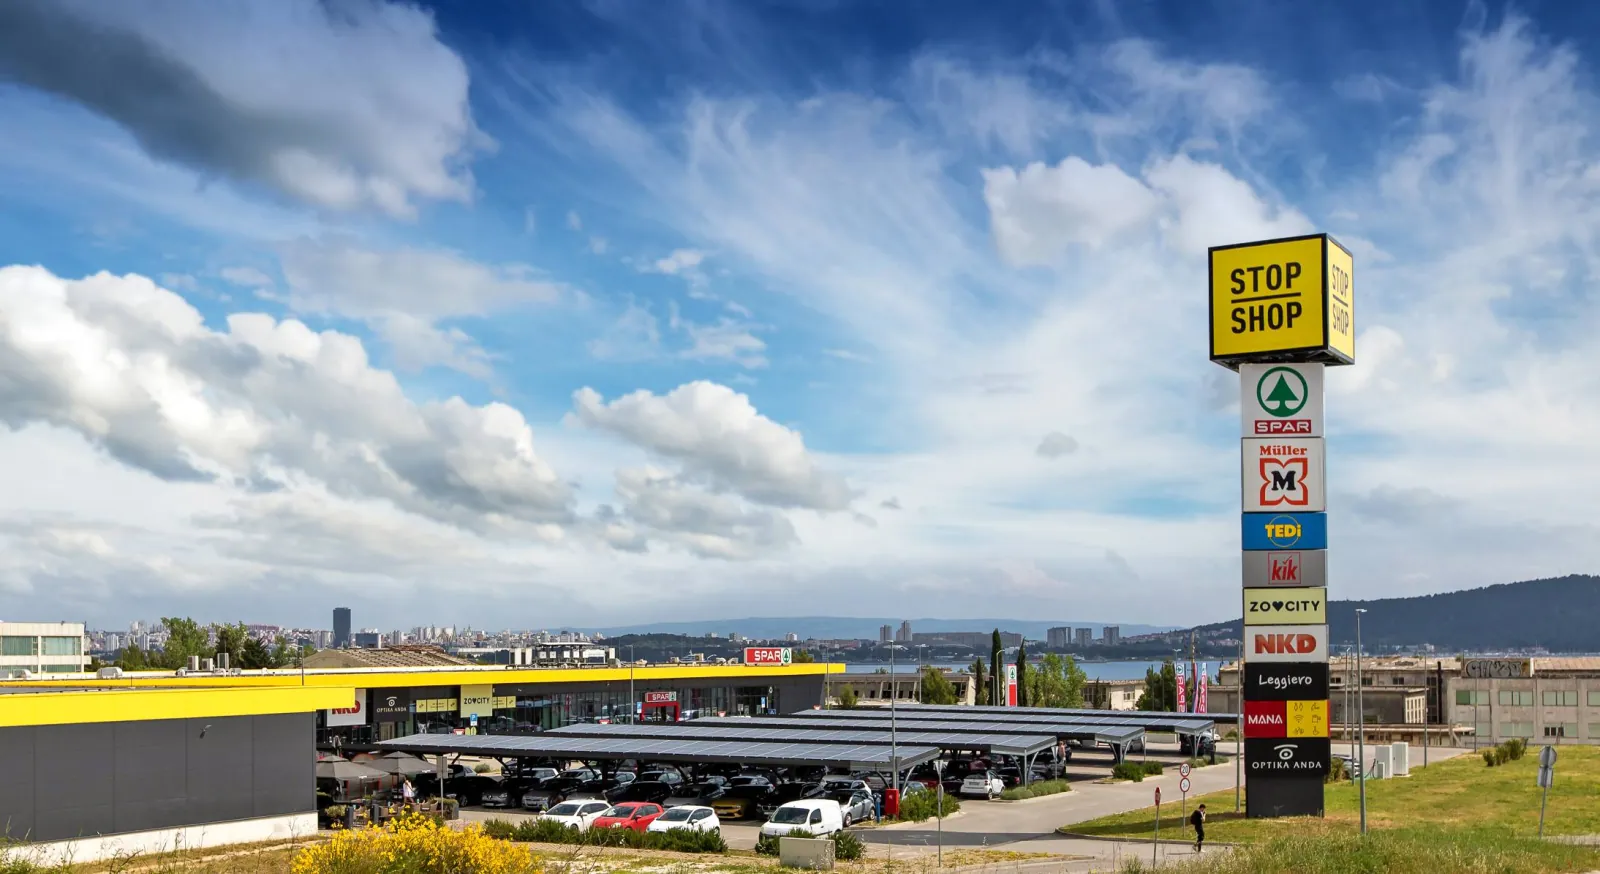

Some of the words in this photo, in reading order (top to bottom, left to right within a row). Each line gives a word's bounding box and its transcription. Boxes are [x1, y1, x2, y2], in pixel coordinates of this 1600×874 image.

[1230, 261, 1302, 295] STOP
[1332, 263, 1349, 298] STOP
[1231, 301, 1302, 334] SHOP
[1332, 303, 1349, 336] SHOP
[1256, 421, 1309, 432] SPAR
[1259, 445, 1308, 456] Müller
[1271, 470, 1297, 491] M
[1264, 523, 1302, 538] TEDi
[1254, 633, 1317, 654] NKD
[754, 650, 781, 661] SPAR
[1258, 674, 1313, 690] Leggiero
[652, 693, 669, 701] SPAR
[1248, 714, 1283, 724] MANA
[1182, 765, 1188, 774] 20
[1251, 761, 1290, 769] OPTIKA
[1293, 761, 1322, 769] ANDA
